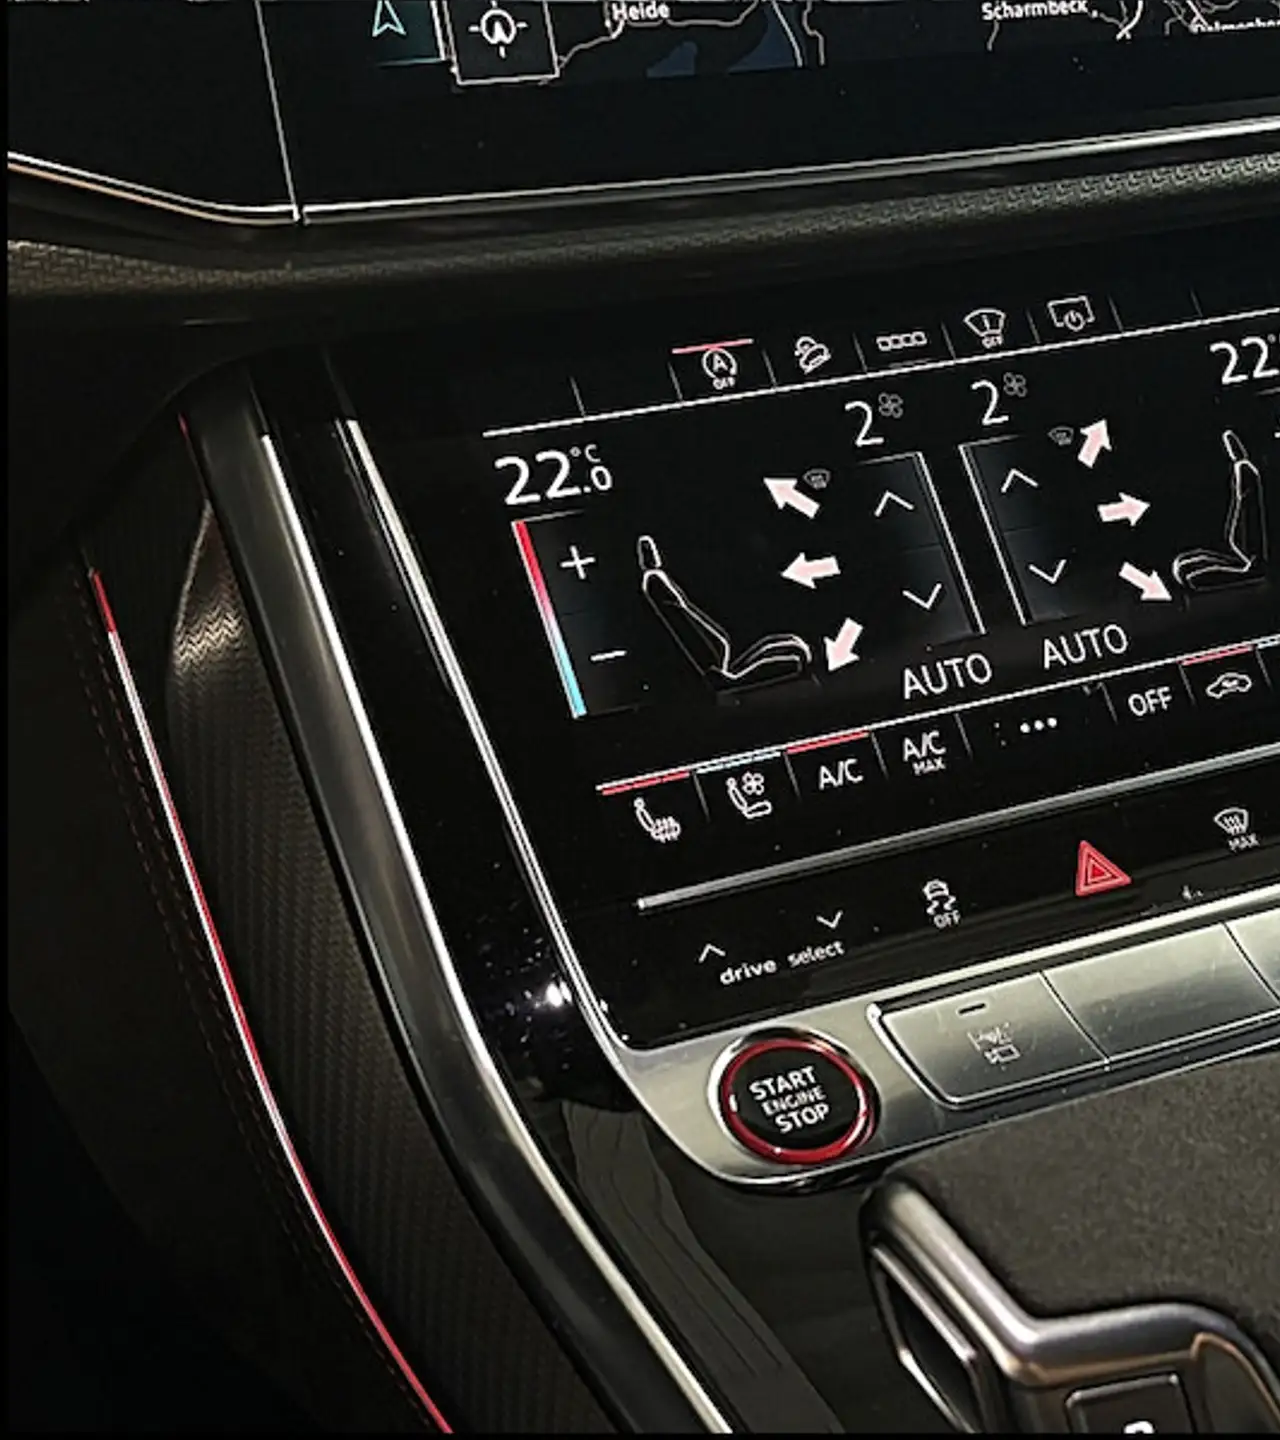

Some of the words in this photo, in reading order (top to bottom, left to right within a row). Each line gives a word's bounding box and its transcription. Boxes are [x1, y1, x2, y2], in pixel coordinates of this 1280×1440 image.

[612, 2, 670, 22] Heide
[982, 0, 1088, 21] Scharmbeck
[713, 376, 736, 389] OFF
[971, 379, 1010, 426] 2
[844, 400, 884, 447] 2
[1042, 624, 1128, 670] AUTO
[902, 653, 993, 700] AUTO
[1128, 686, 1173, 717] OFF
[903, 731, 946, 761] A/C
[819, 758, 864, 790] A/C
[913, 757, 946, 776] MAX
[1228, 833, 1261, 852] MAX
[933, 910, 961, 928] OFF
[720, 959, 777, 985] drive
[788, 941, 844, 967] select
[749, 1066, 815, 1100] START
[761, 1087, 827, 1116] ENGINE
[775, 1104, 829, 1133] STOP
